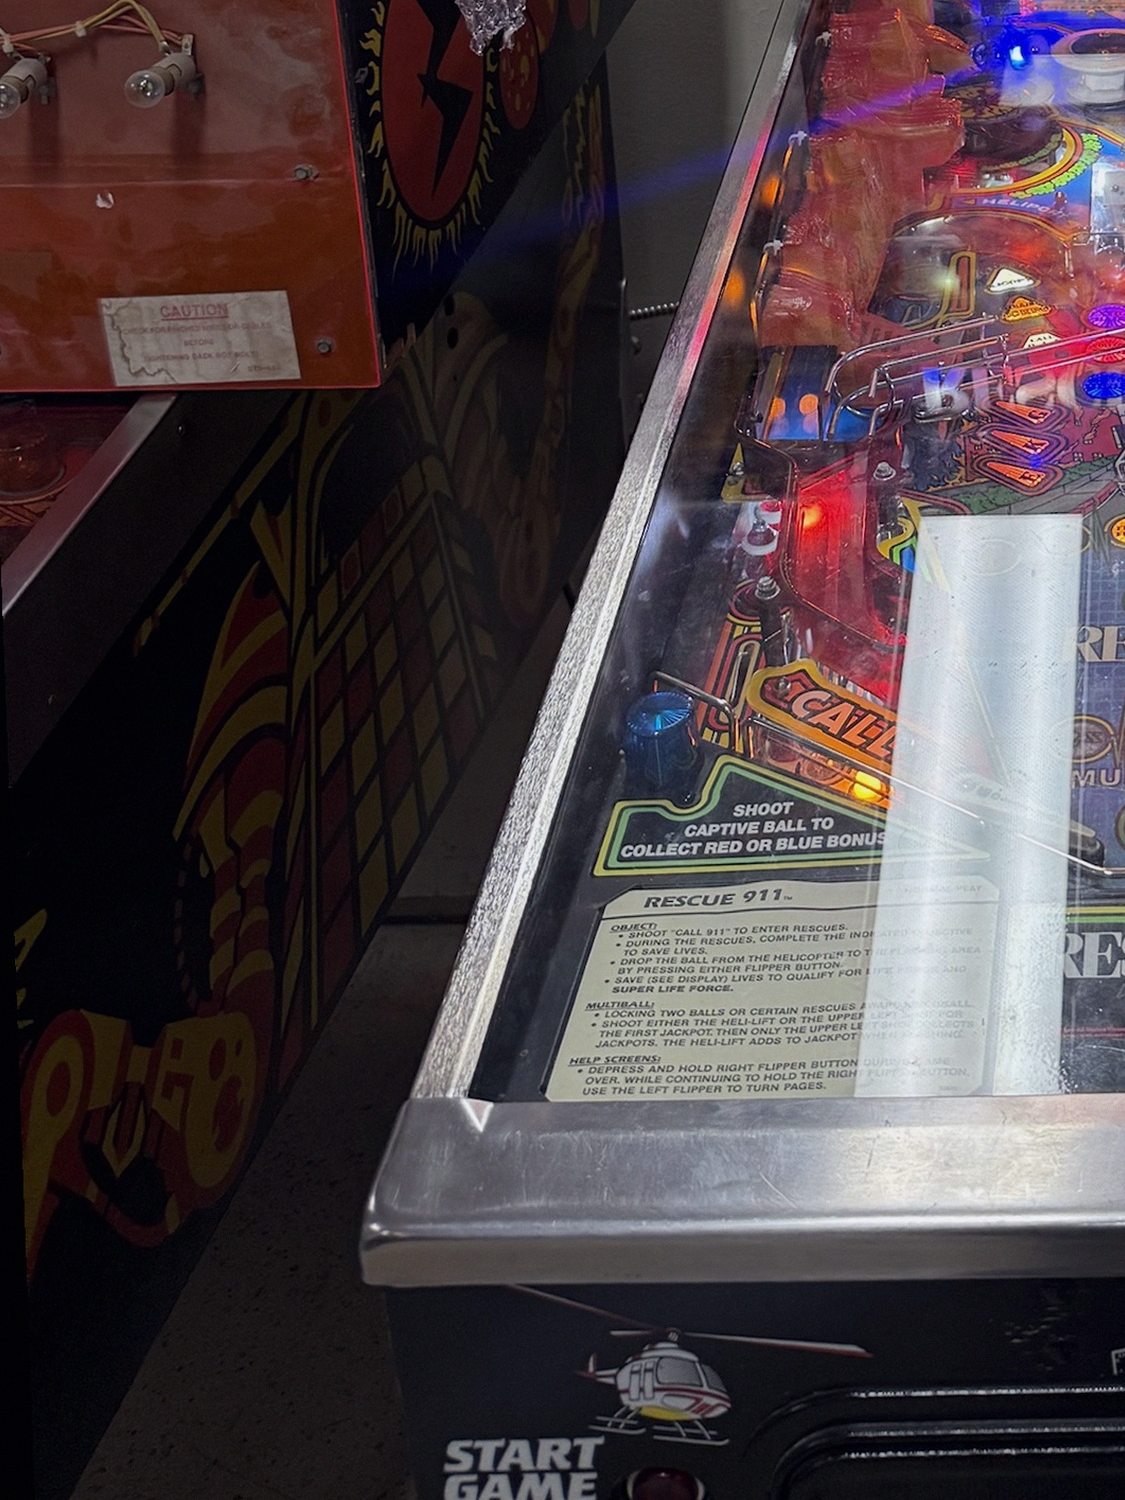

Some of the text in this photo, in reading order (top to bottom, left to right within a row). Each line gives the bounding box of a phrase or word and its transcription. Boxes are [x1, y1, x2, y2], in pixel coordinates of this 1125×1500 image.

[160, 302, 229, 319] CAUTION
[791, 688, 898, 759] CALL
[732, 801, 795, 818] SHOOT
[684, 816, 835, 838] CAPTIVE BALL TO
[620, 831, 888, 858] COLLECT RED OR BLUE BONUS
[643, 888, 783, 909] RESCUE 911
[628, 928, 668, 939] SHOOT
[732, 926, 749, 936] TO
[751, 924, 790, 934] ENTER
[792, 923, 849, 934] RESCUES.
[624, 937, 672, 949] DURING
[673, 937, 697, 947] THE
[758, 932, 820, 945] COMPLETE
[822, 932, 846, 942] THE
[618, 957, 653, 967] DROP
[655, 956, 678, 966] THE
[680, 956, 709, 966] BALL
[711, 954, 746, 965] FROM
[748, 953, 771, 963] THE
[773, 950, 844, 963] HELICOPTER
[848, 949, 862, 958] TO
[622, 946, 709, 957] TO SAVE LIVES.
[617, 960, 844, 976] BY PRESSING EITHER FLIPPER BUTTON.
[612, 984, 735, 994] SUPER LIFE FORCE.
[585, 1001, 655, 1011] MULTIBALL:
[604, 1003, 857, 1020] LOCKING TWO BALLS OR CERTAIN RESCUES
[595, 1032, 859, 1049] JACKPOTS. THE HELI-LIFT ADDS TO JACKPOT
[568, 1054, 662, 1065] HELP SCREENS:
[586, 1064, 645, 1076] DEPRESS
[648, 1064, 676, 1074] AND
[678, 1063, 714, 1074] HOLD
[715, 1062, 755, 1073] RIGHT
[757, 1061, 807, 1072] FLIPPER
[810, 1058, 859, 1069] BUTTON
[582, 1081, 827, 1096] USE THE LEFT FLIPPER TO TURN PAGES.
[443, 1434, 605, 1473] START
[443, 1471, 598, 1500] GAME
